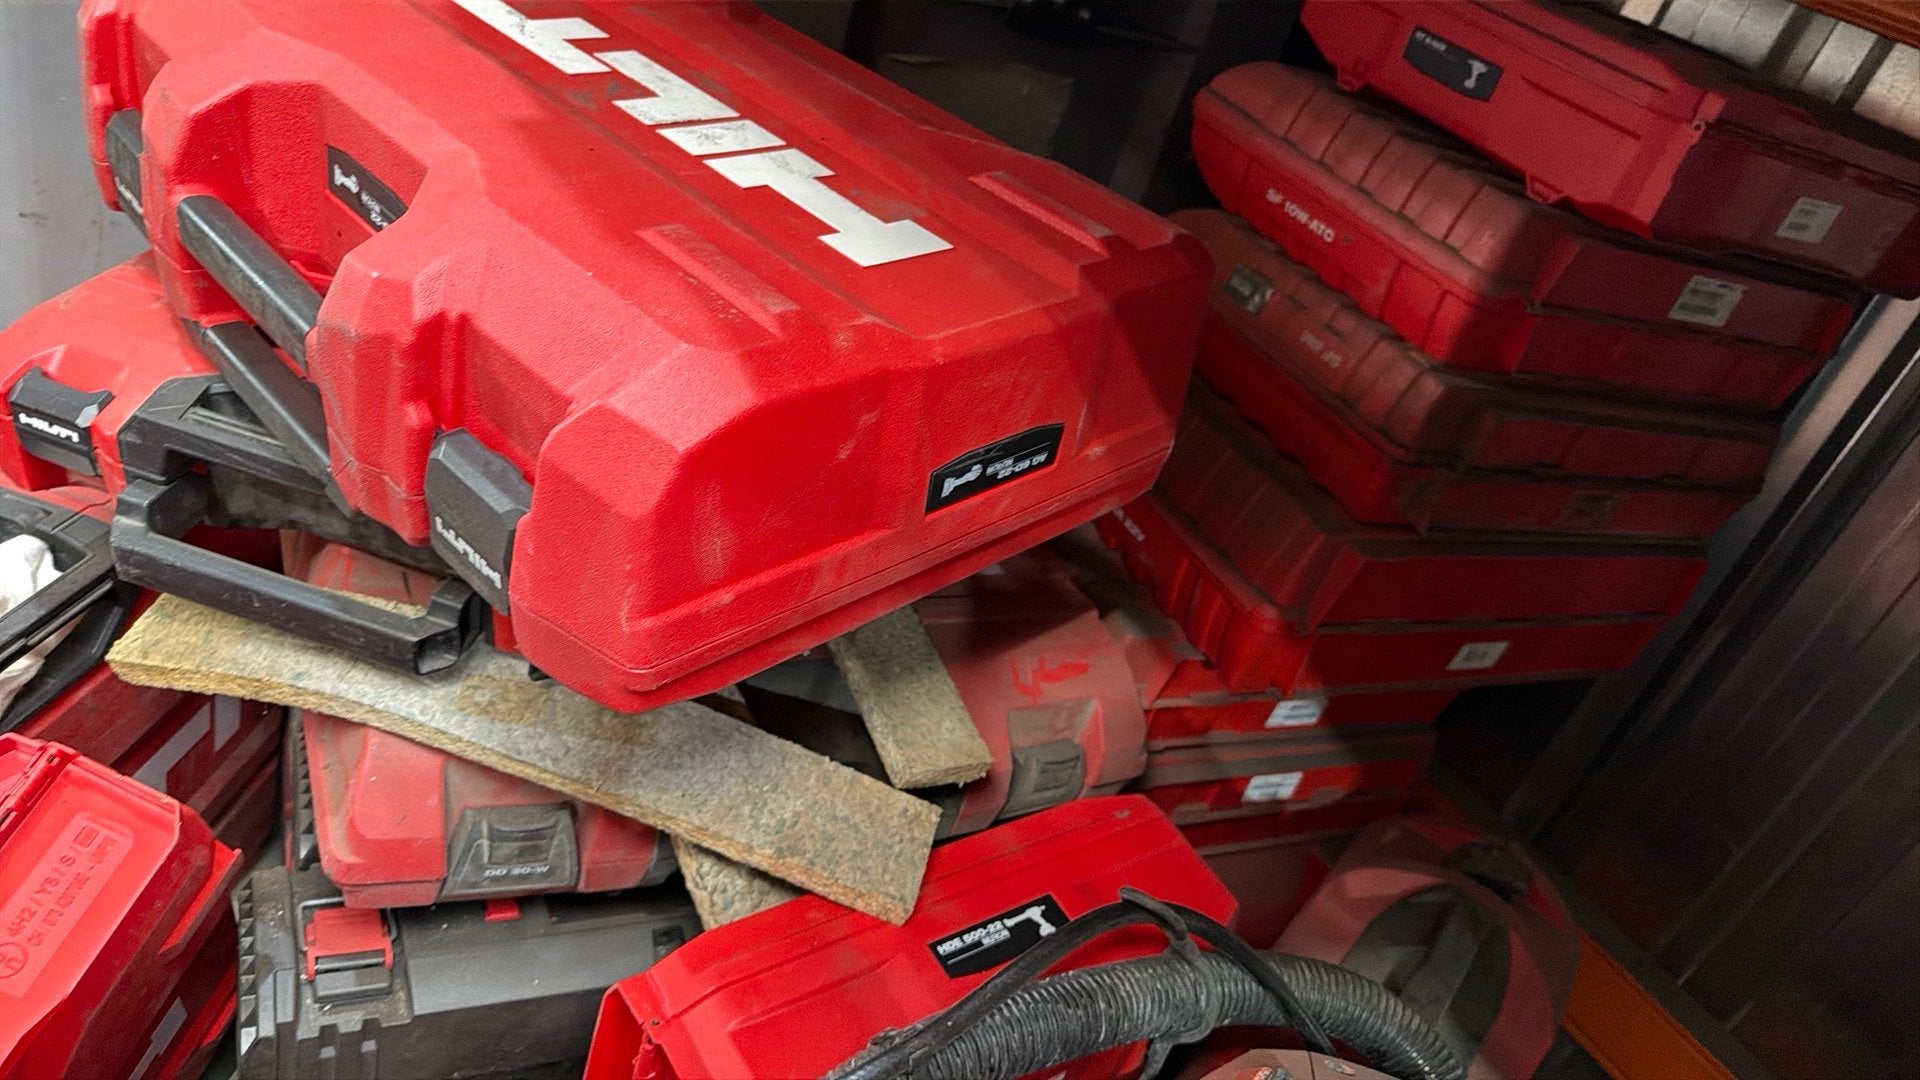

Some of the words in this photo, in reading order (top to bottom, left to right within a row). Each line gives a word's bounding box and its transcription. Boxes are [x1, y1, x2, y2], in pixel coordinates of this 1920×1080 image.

[434, 515, 502, 590] HILTI
[936, 936, 965, 956] HDE
[961, 920, 1004, 944] 500-22
